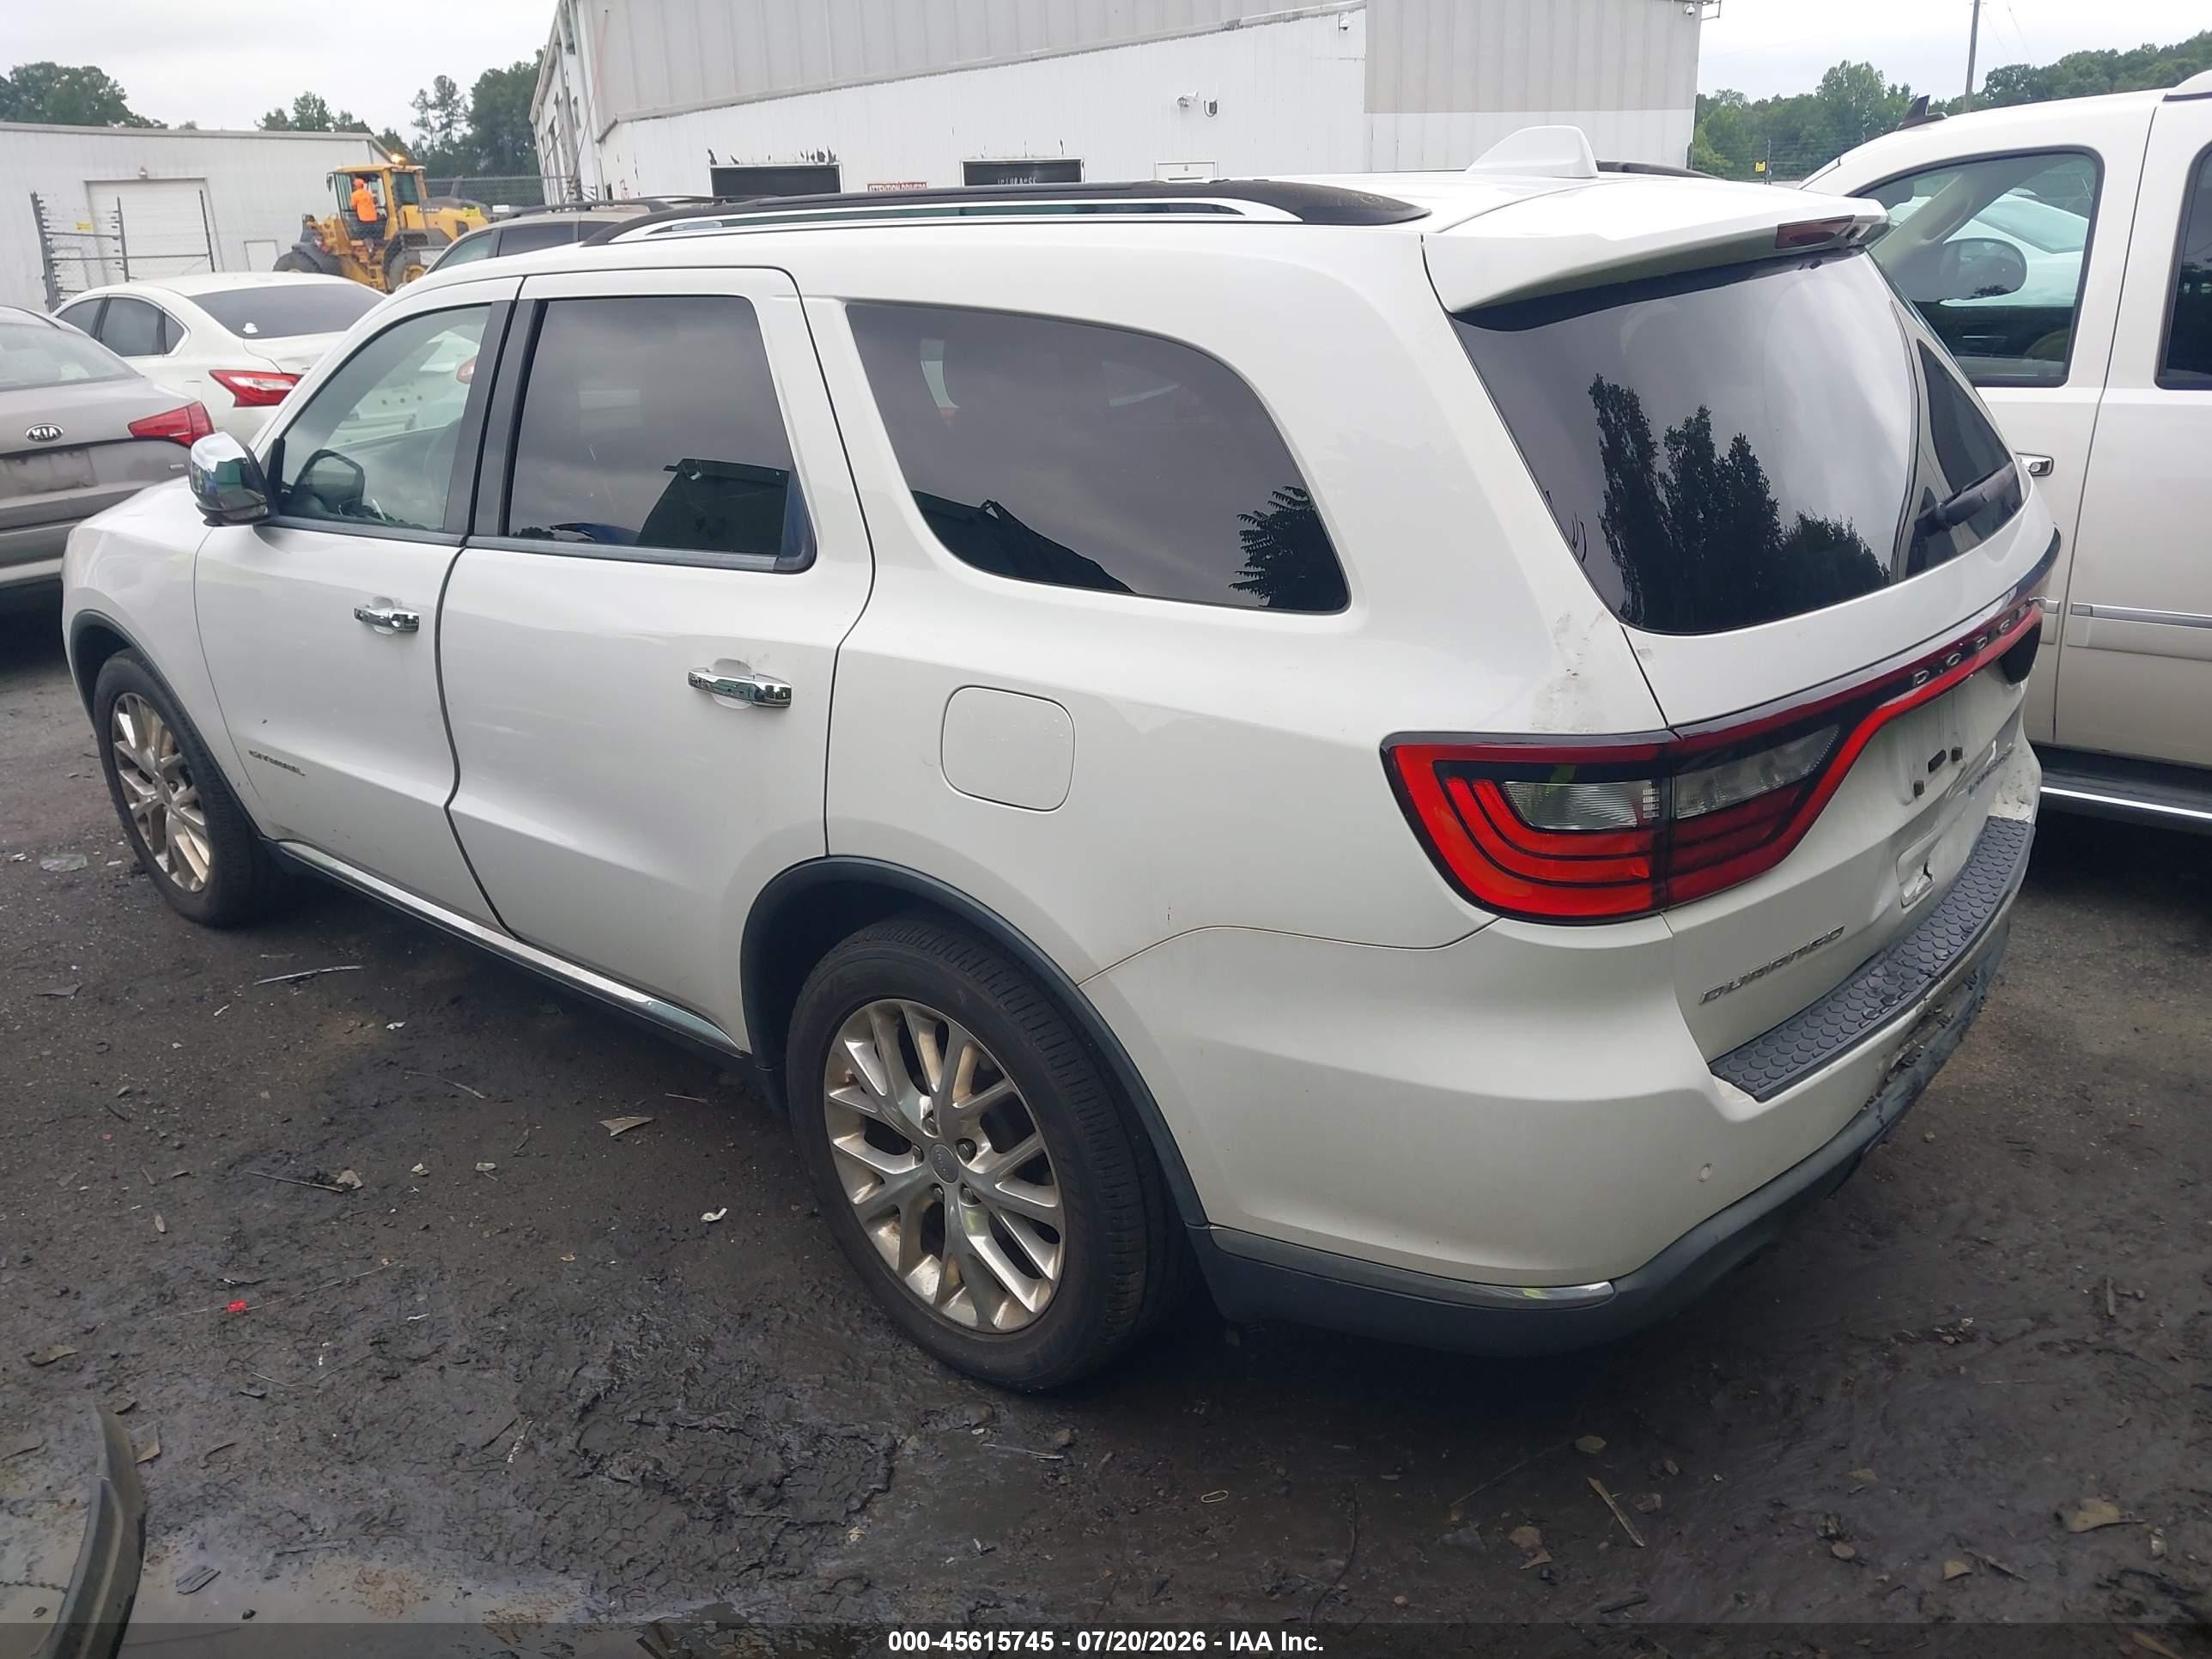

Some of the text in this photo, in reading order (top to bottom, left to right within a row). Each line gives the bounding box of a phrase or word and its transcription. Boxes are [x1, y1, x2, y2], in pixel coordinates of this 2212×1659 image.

[997, 176, 1036, 185] INSURANCE
[30, 427, 58, 440] KIA
[1699, 925, 1845, 1005] DURANGO
